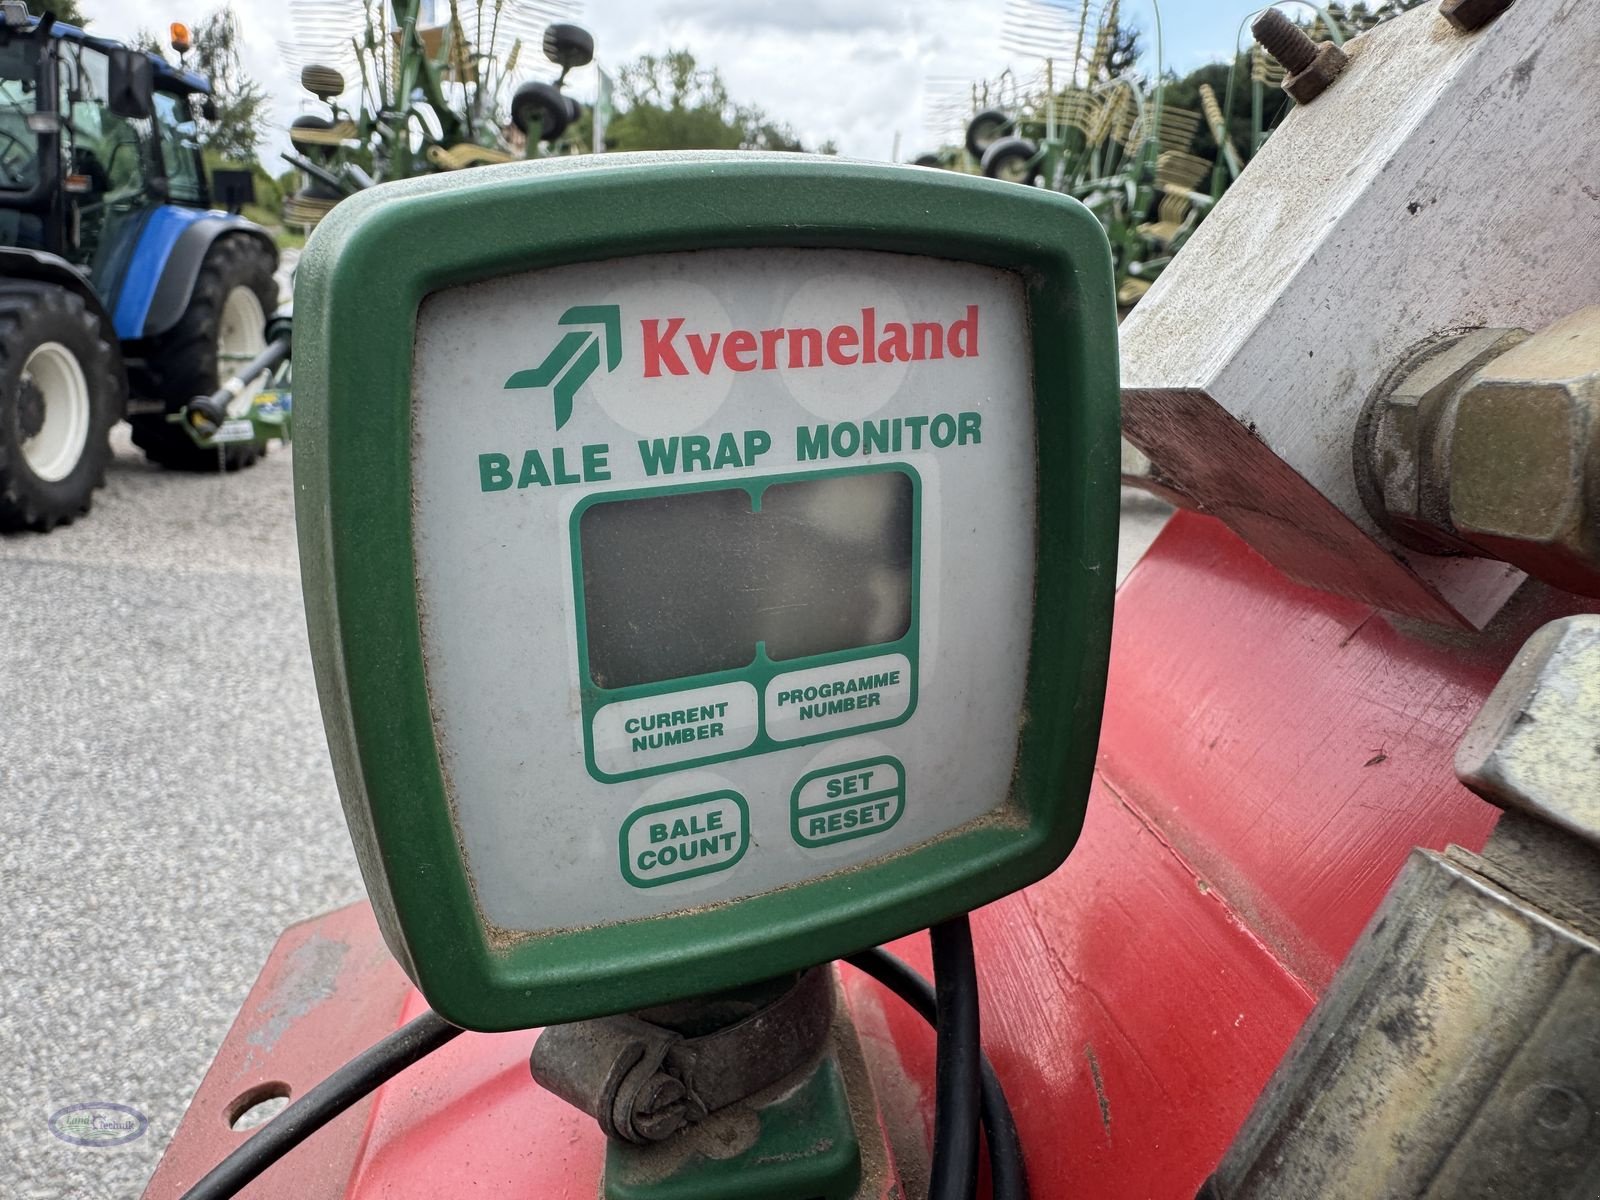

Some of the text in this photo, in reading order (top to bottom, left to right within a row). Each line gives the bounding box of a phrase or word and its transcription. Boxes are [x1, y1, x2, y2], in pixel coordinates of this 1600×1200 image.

[640, 305, 979, 379] Kverneland
[479, 412, 982, 492] BALE WRAP MONITOR
[777, 671, 900, 706] PROGRAMME
[625, 702, 728, 733] CURRENT
[799, 692, 881, 720] NUMBER
[632, 722, 724, 752] NUMBER
[826, 771, 874, 798] SET
[649, 810, 723, 843] BALE
[809, 801, 890, 836] RESET
[637, 831, 736, 870] COUNT
